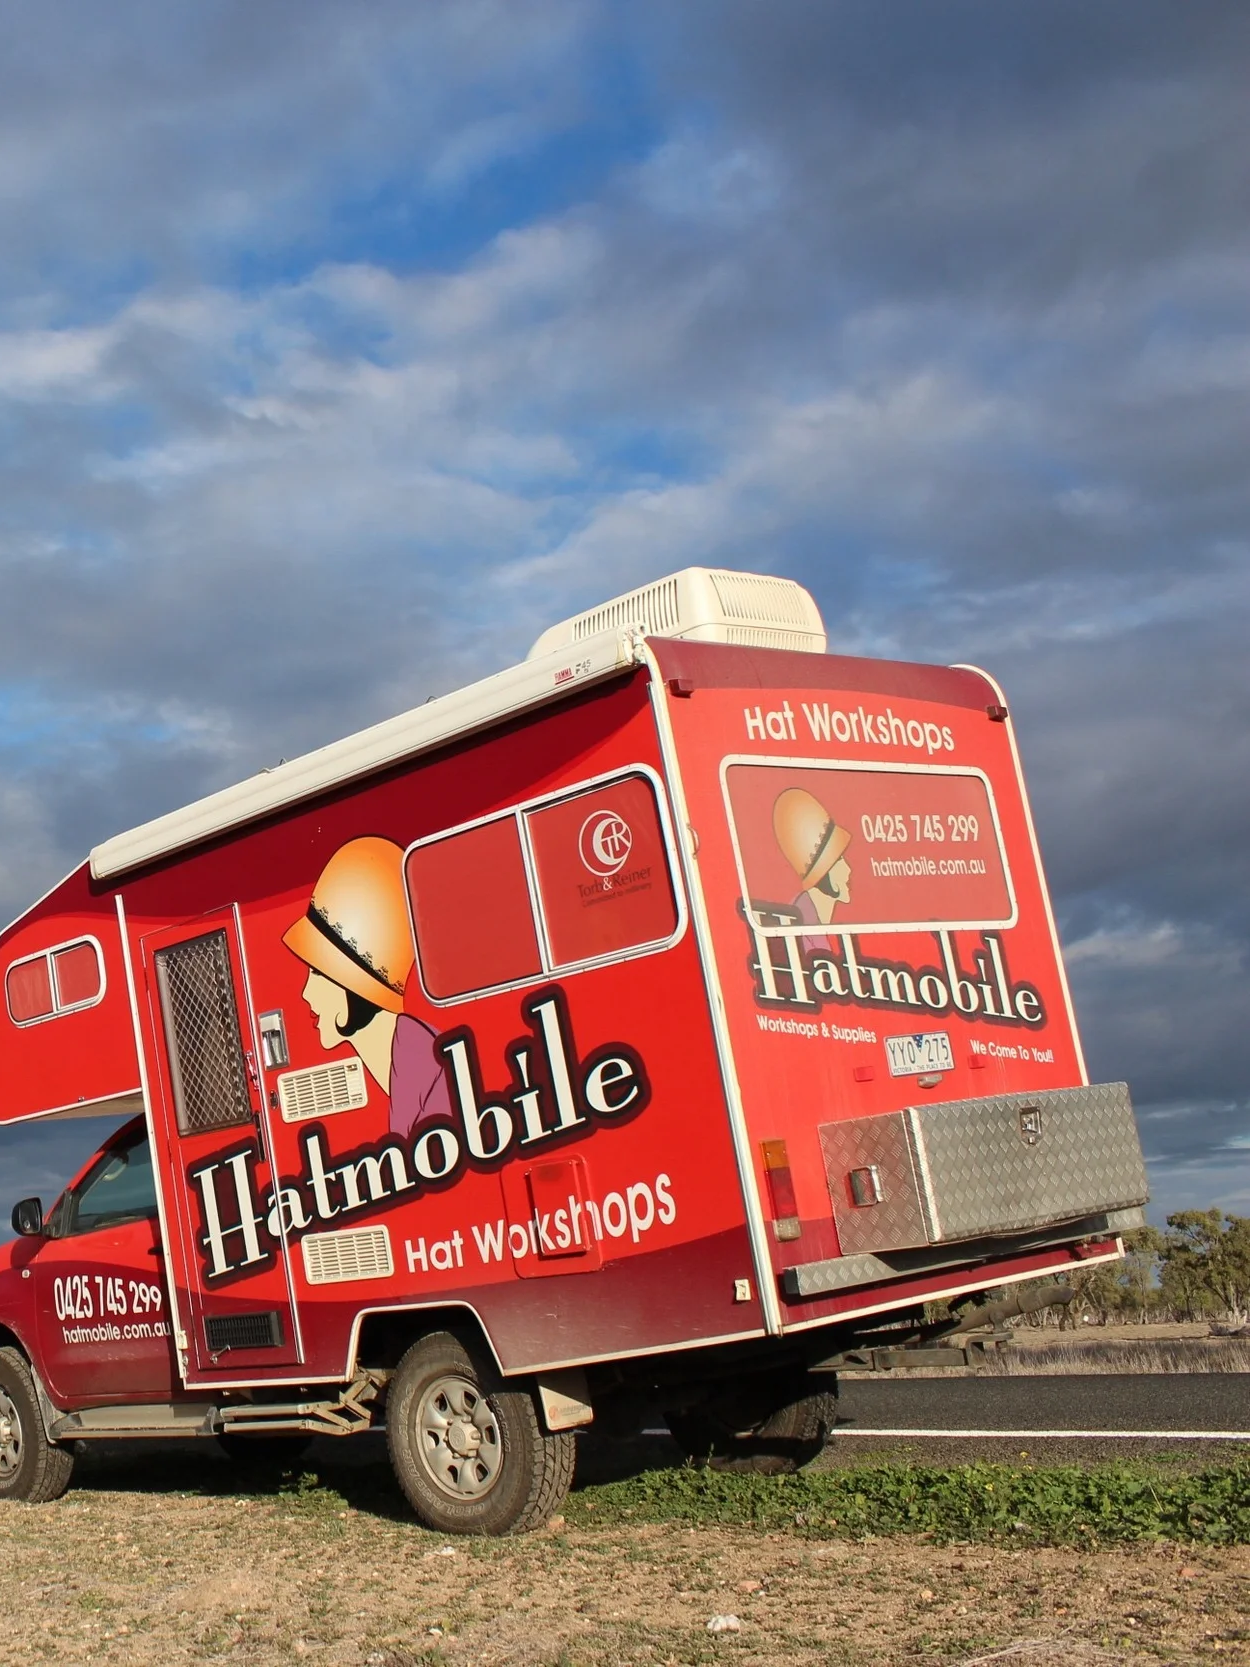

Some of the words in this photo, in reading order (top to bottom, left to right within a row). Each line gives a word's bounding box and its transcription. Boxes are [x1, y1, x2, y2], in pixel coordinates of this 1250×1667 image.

[743, 700, 798, 742] Hat
[801, 702, 955, 755] Workshops
[861, 814, 908, 843] 0425
[910, 814, 944, 842] 745
[948, 814, 979, 842] 299
[871, 855, 986, 878] hatmobile.com.au
[603, 876, 613, 891] &
[743, 908, 1042, 1022] Hatmobile
[756, 1014, 819, 1040] Workshops
[821, 1022, 831, 1038] &
[831, 1024, 877, 1044] Supplies
[924, 1037, 949, 1063] 275
[970, 1039, 987, 1055] We
[988, 1041, 1017, 1059] Come
[1017, 1045, 1030, 1061] To
[193, 1000, 639, 1278] Hatmobile
[404, 1236, 464, 1274] Hat
[471, 1173, 676, 1264] Workshops
[54, 1275, 93, 1321] 0425
[95, 1276, 127, 1317] 745
[129, 1280, 162, 1313] 299
[62, 1321, 171, 1344] hatmobile.com.au
